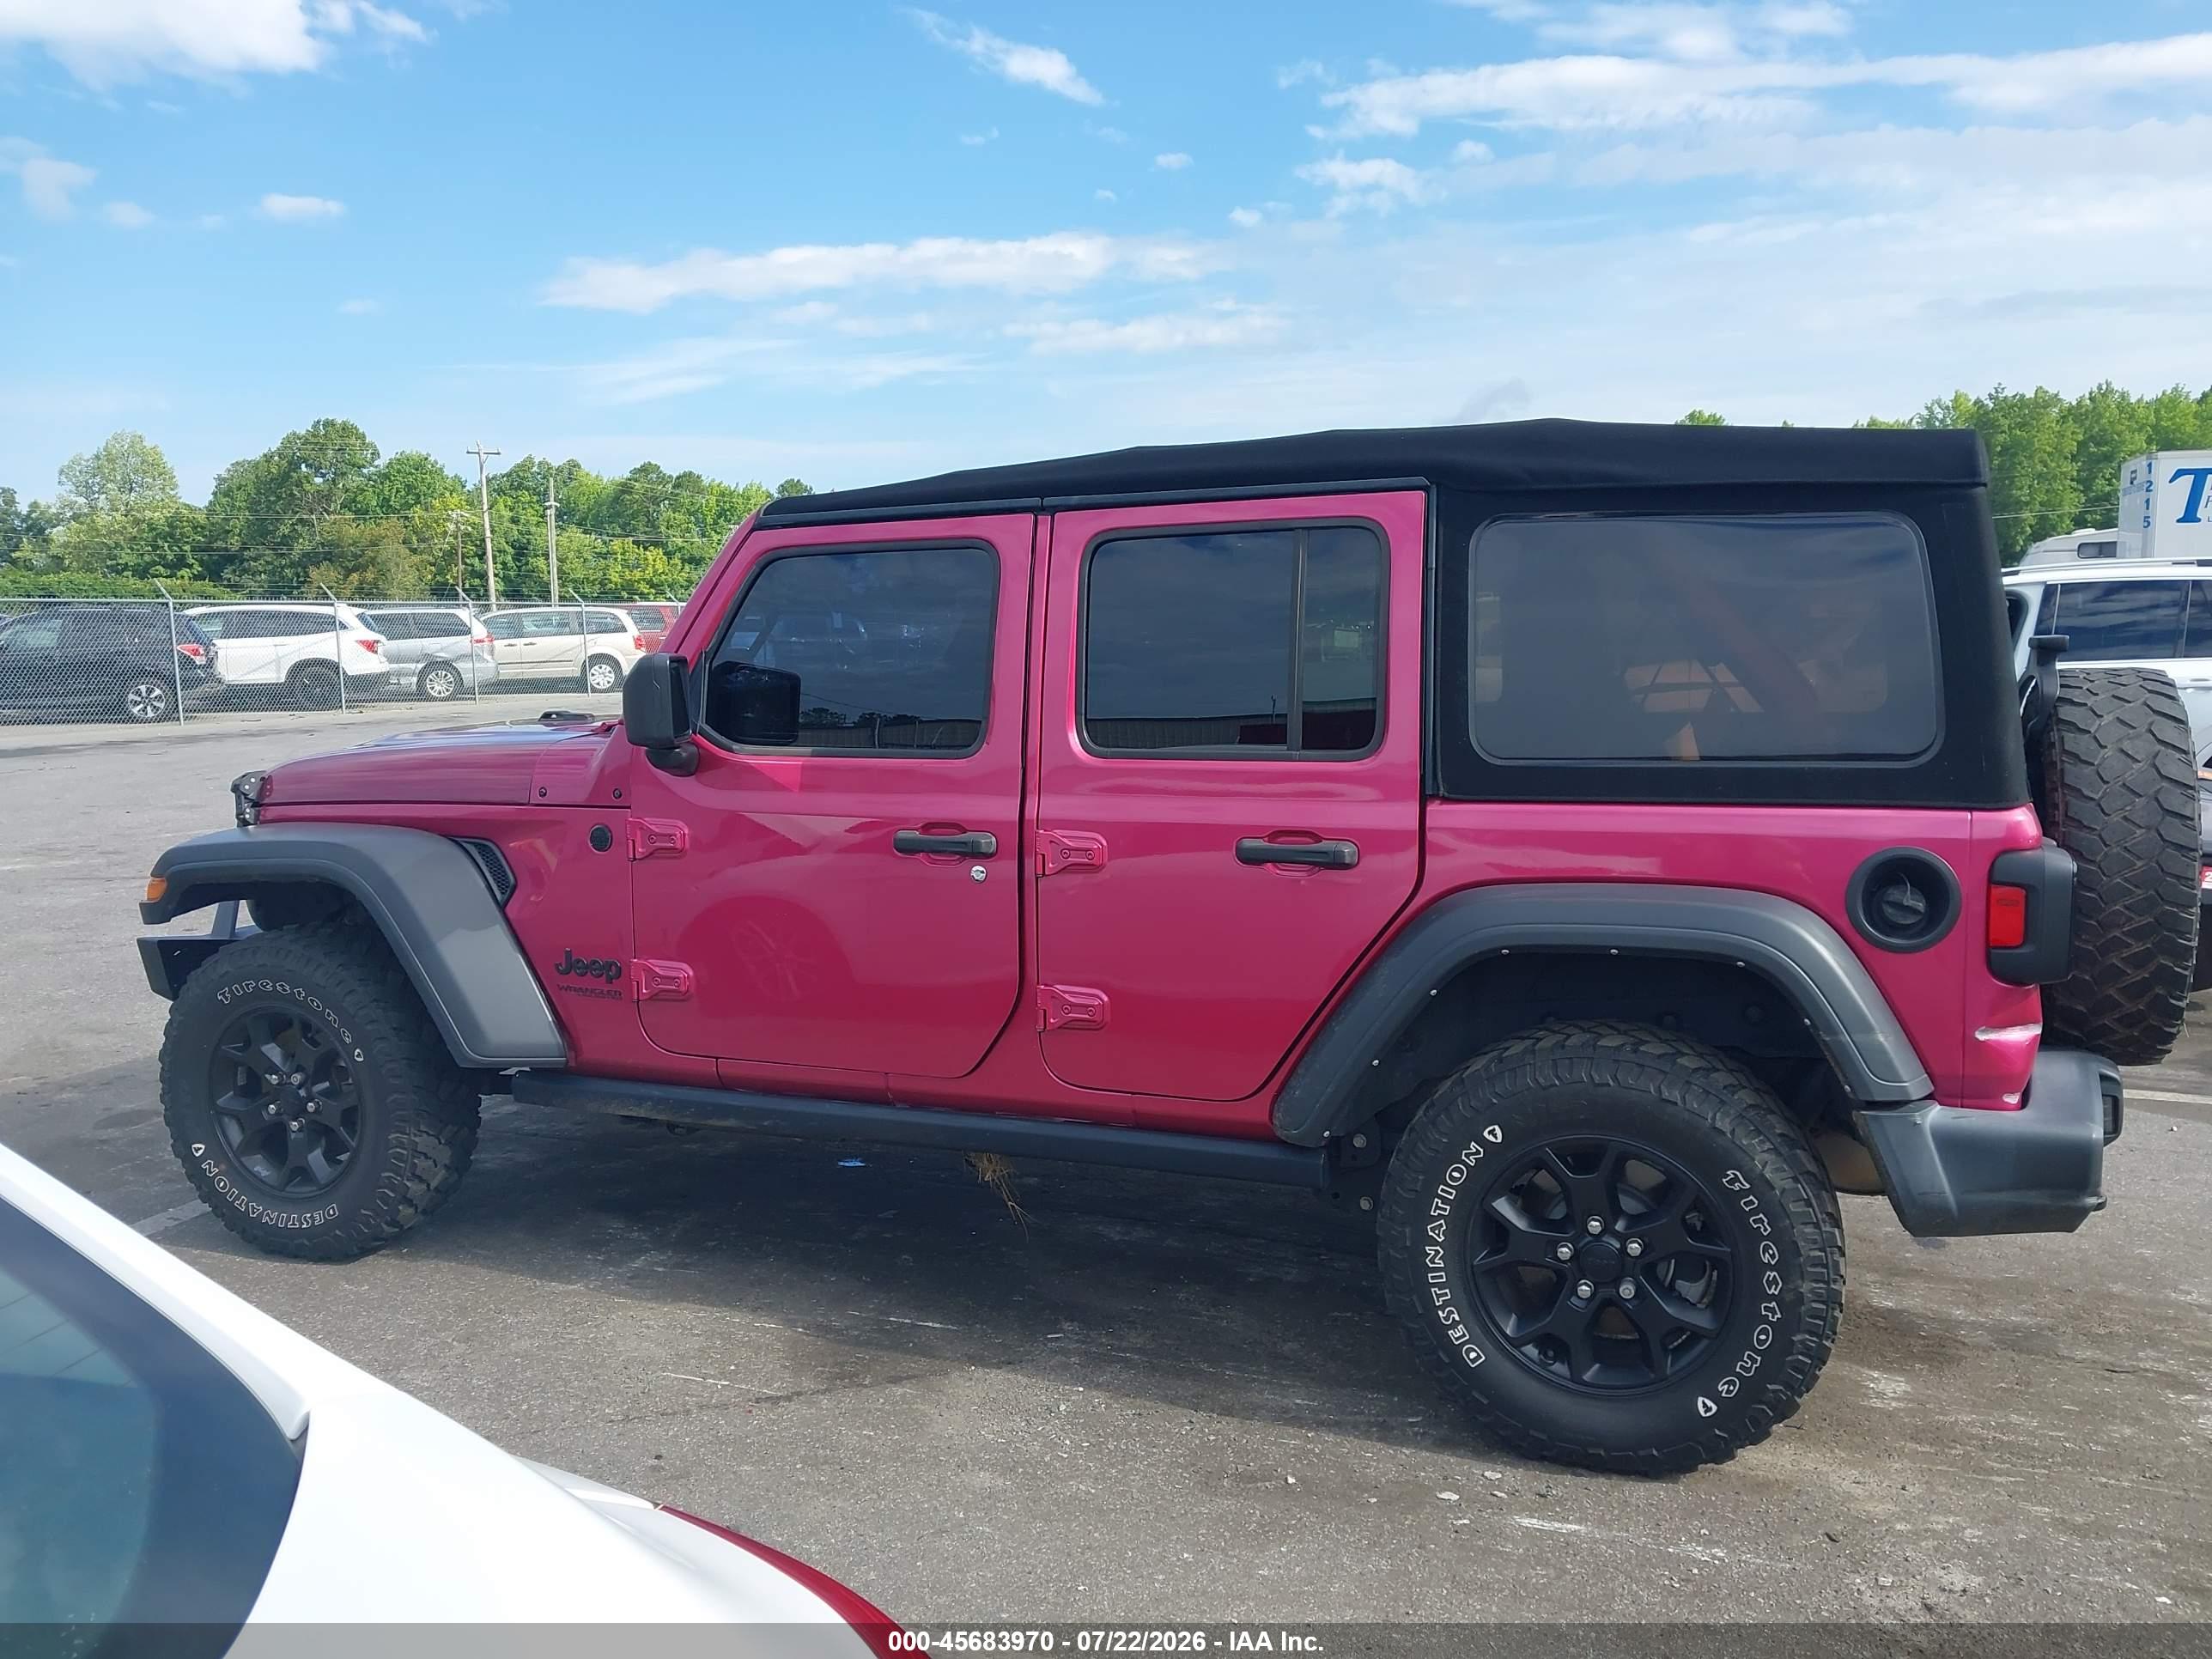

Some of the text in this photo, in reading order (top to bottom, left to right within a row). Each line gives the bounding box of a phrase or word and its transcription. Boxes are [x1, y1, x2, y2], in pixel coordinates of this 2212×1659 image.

[554, 947, 622, 984] Jeep
[217, 979, 352, 1044] Firestone
[201, 1159, 339, 1229] DESTINATION
[1424, 1141, 1486, 1368] DESTINATION
[1718, 1170, 1783, 1398] Firestone
